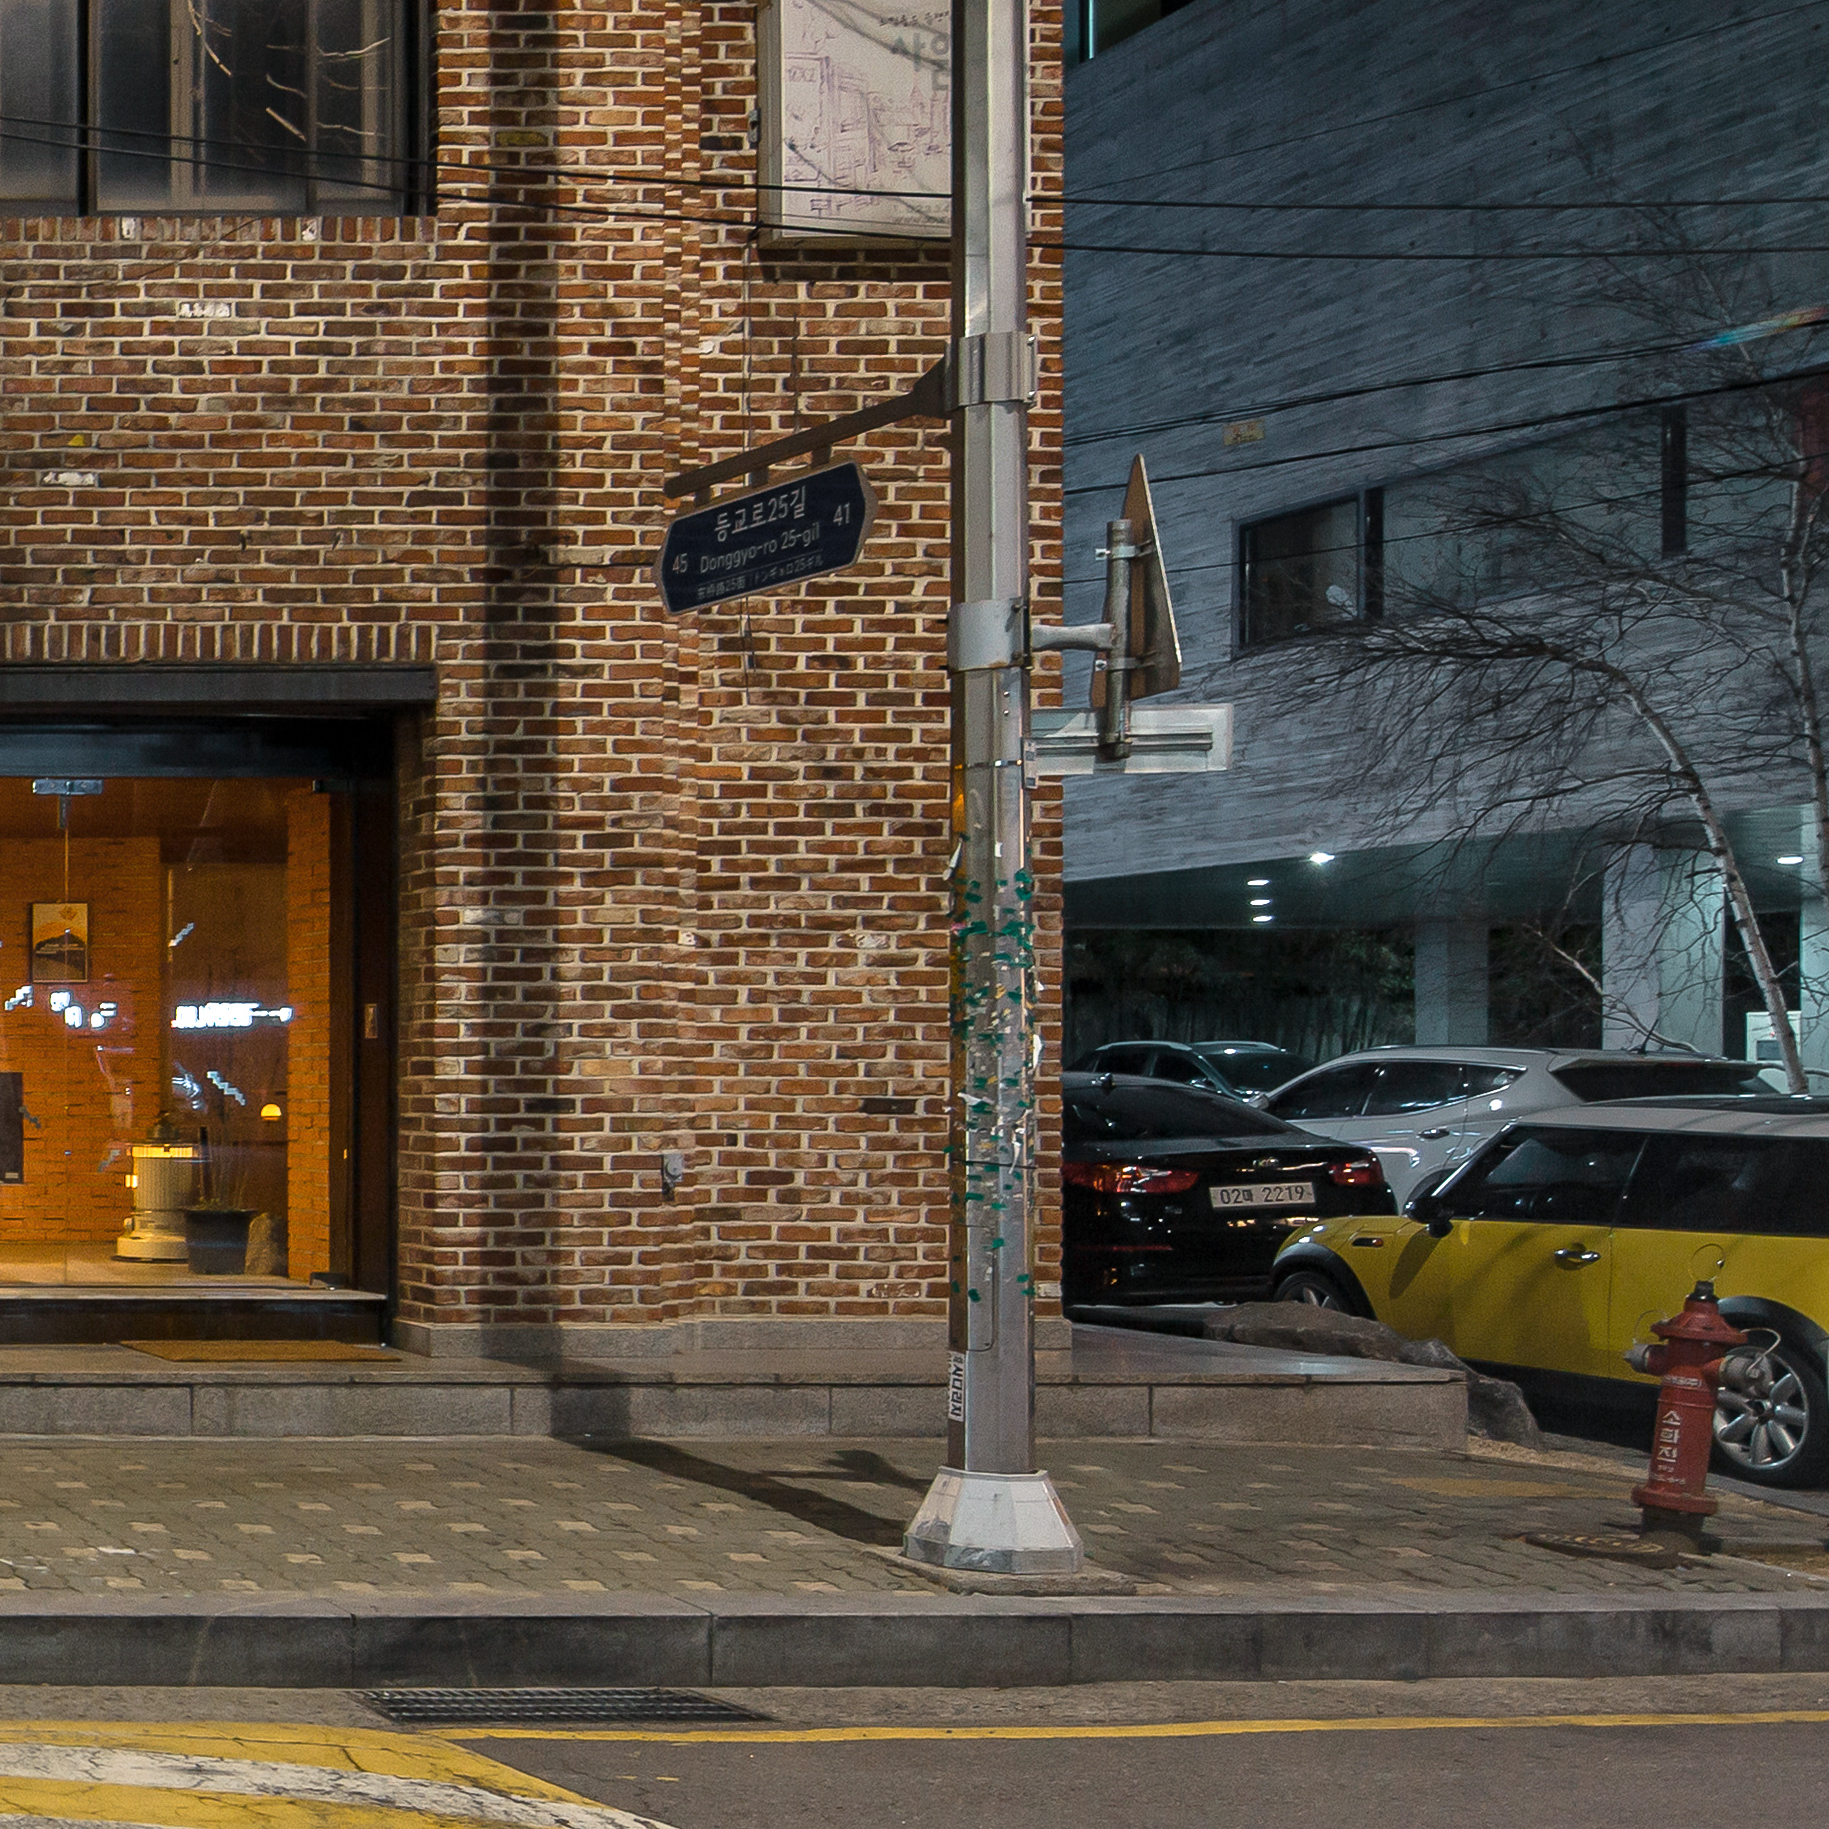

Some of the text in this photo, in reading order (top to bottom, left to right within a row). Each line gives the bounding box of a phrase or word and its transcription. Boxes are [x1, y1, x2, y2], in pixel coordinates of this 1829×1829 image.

[832, 502, 851, 527] 41
[700, 522, 821, 573] Donggyo-ro 25-gil
[672, 553, 689, 574] 45
[1262, 1185, 1304, 1203] 2219
[1657, 1410, 1681, 1463] 소화전
